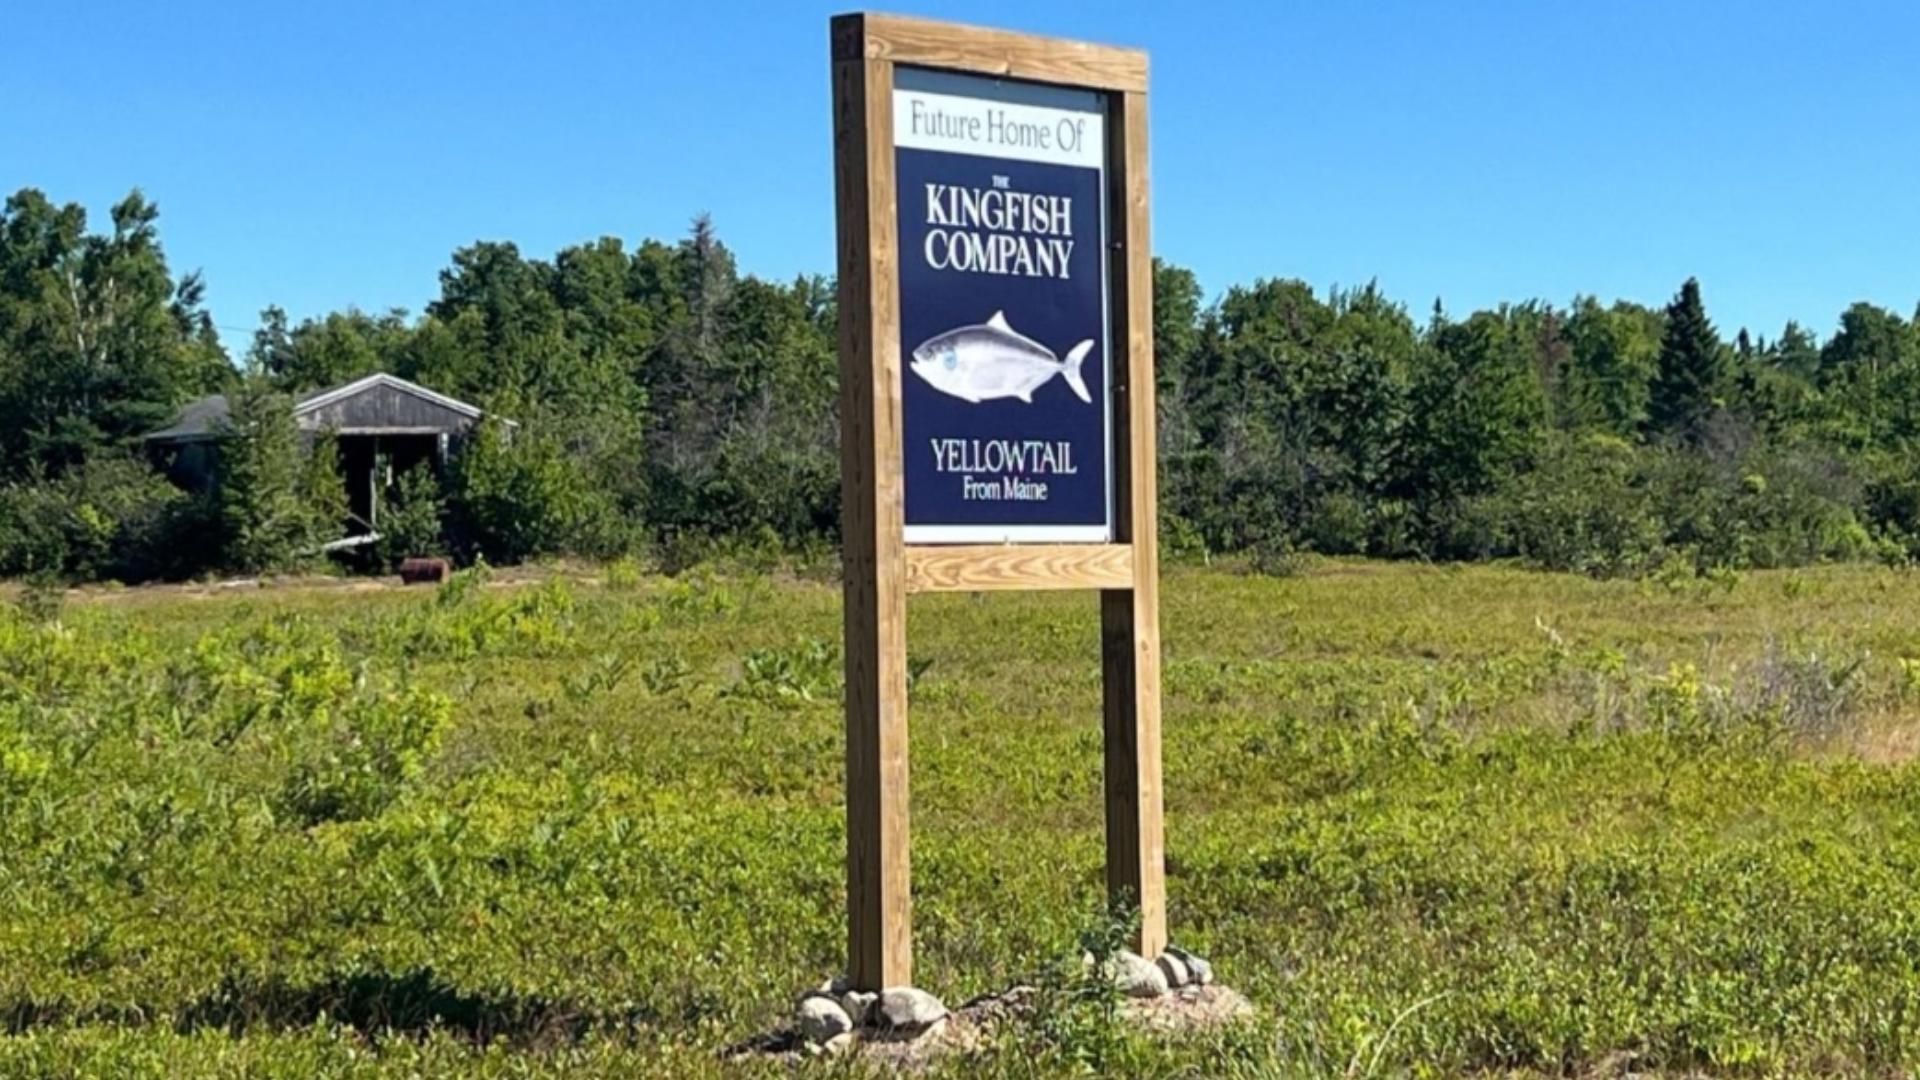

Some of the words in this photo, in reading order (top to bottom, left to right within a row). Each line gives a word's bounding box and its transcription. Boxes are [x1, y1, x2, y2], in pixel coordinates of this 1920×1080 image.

[911, 99, 981, 142] Future
[987, 109, 1050, 149] Home
[1056, 117, 1085, 152] Of
[925, 183, 1072, 236] KINGFISH
[925, 228, 1074, 279] COMPANY
[930, 438, 1077, 474] YELLOWTAIL
[963, 475, 1000, 500] From
[1003, 476, 1048, 500] Maine
